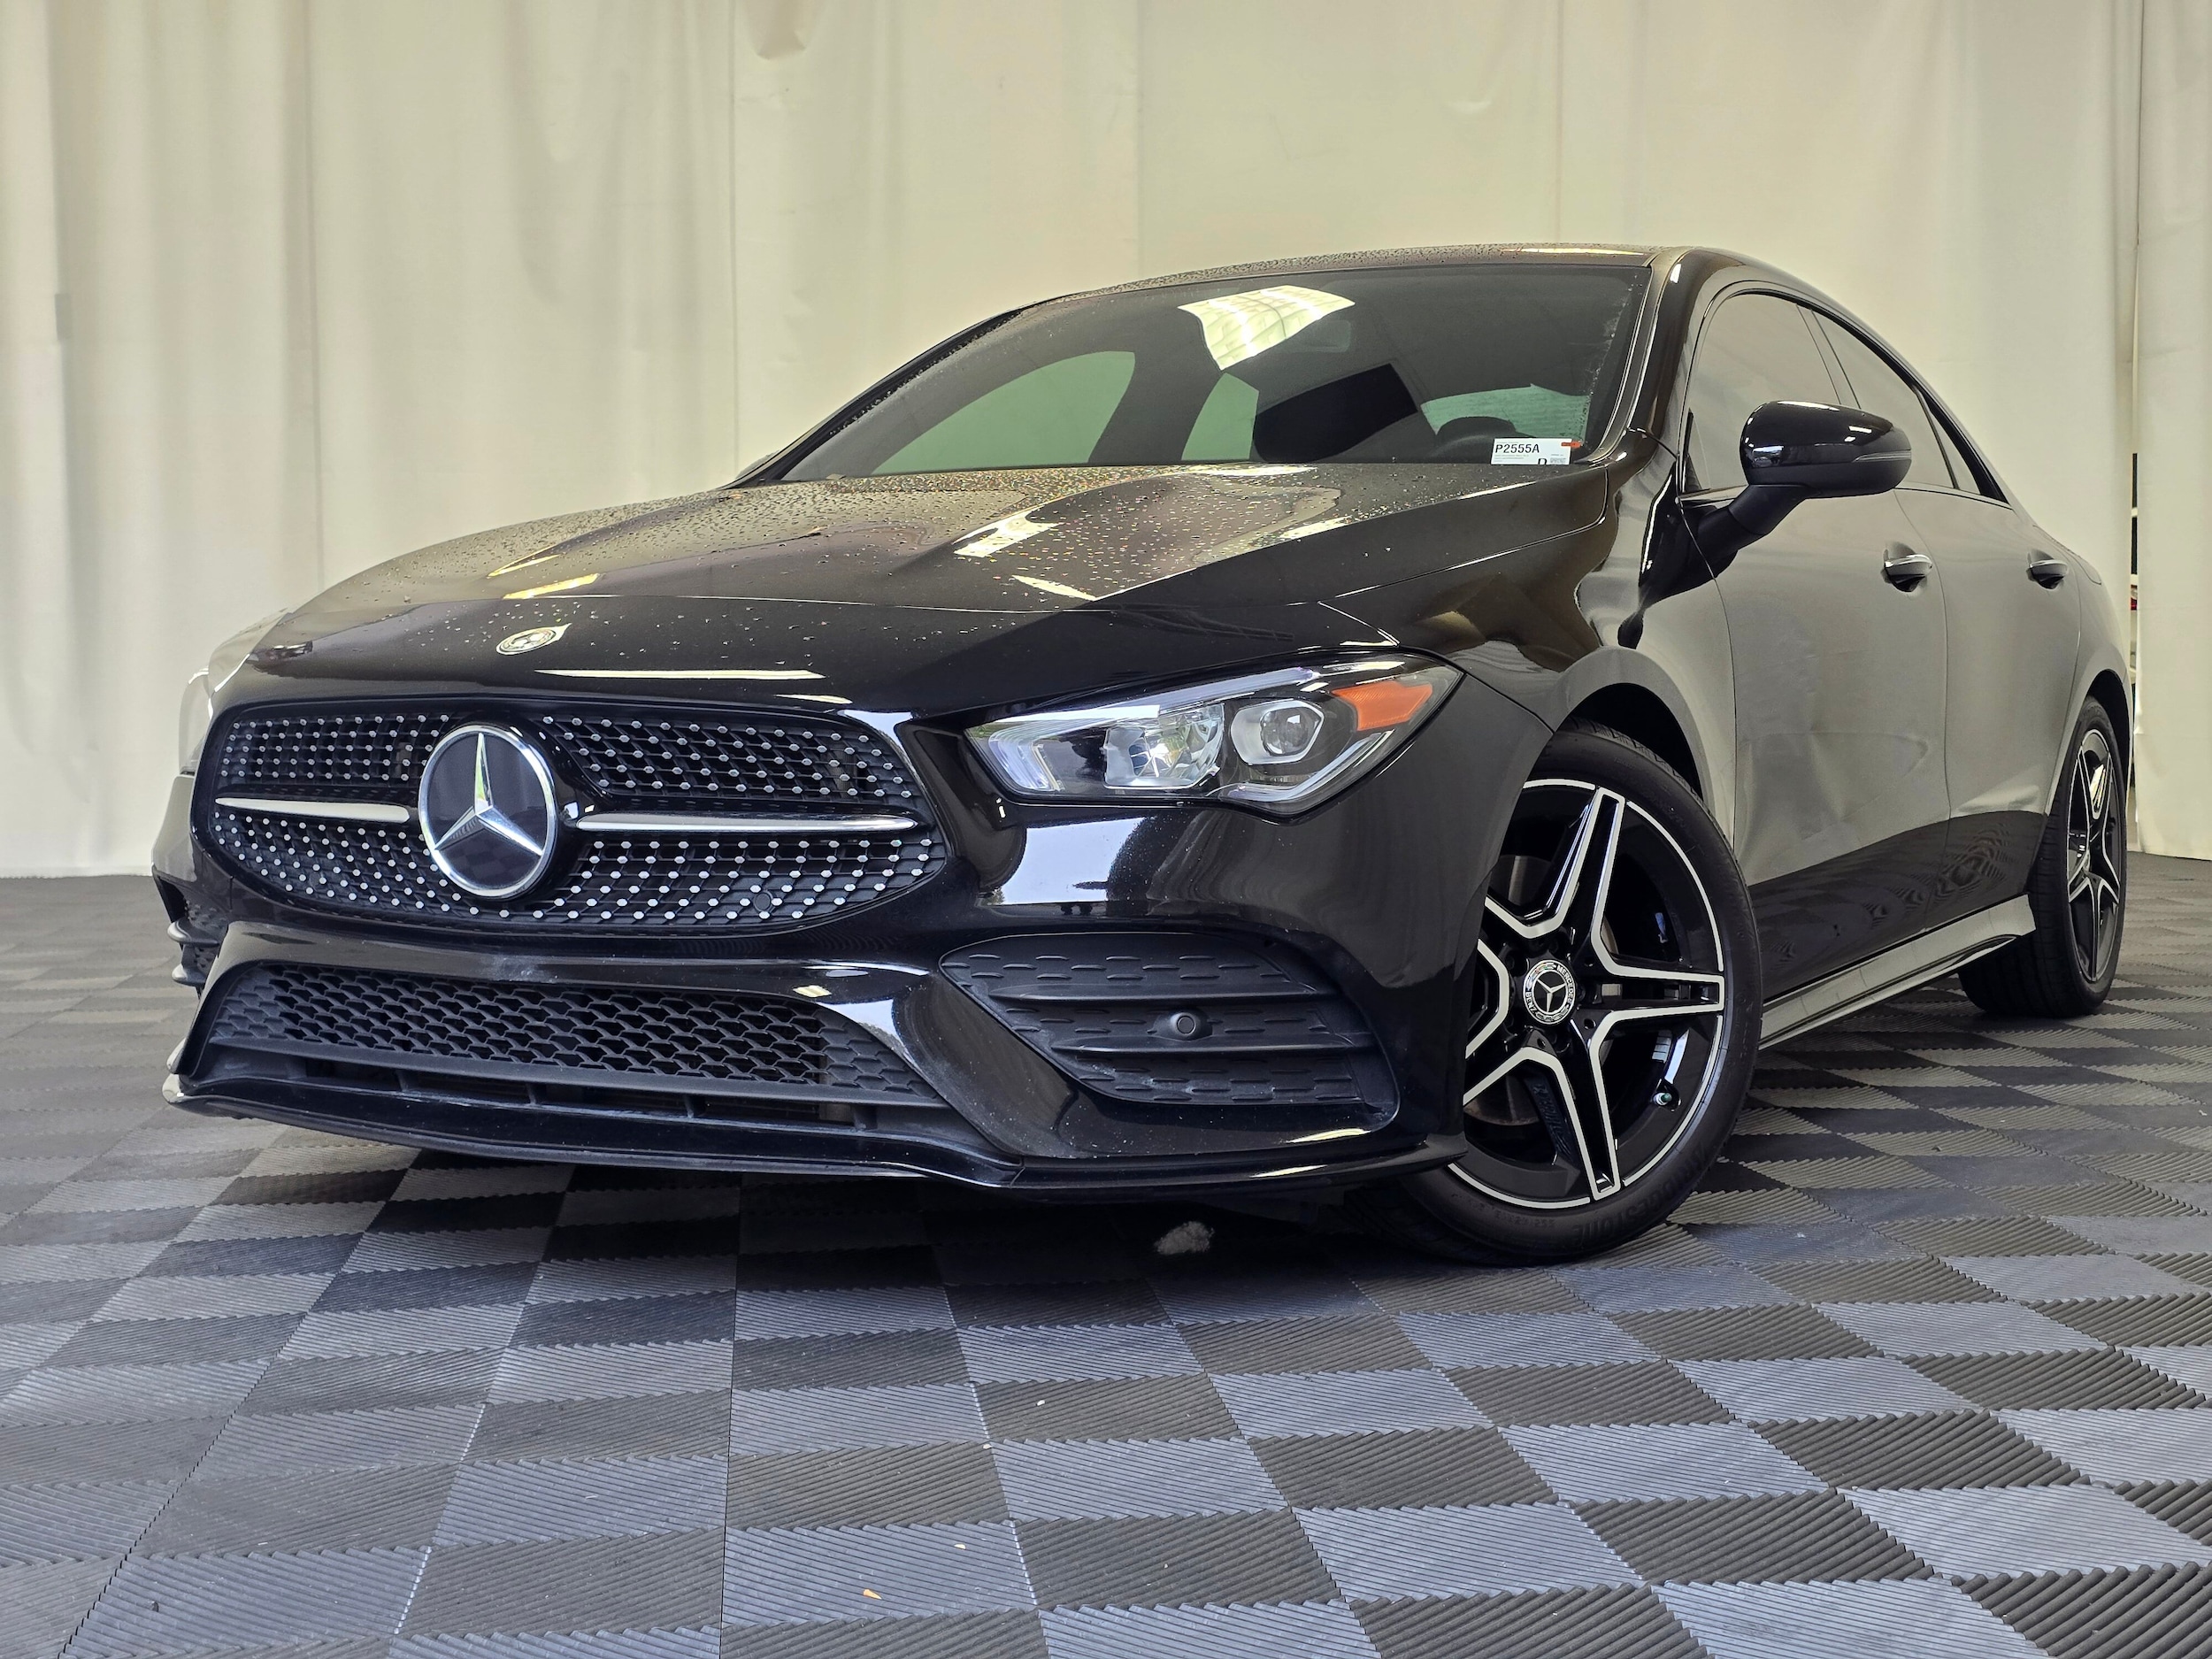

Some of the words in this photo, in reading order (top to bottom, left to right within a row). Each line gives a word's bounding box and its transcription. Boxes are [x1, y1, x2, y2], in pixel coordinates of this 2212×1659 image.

[1495, 443, 1540, 454] P2555A
[1556, 965, 1574, 1004] MERCEDES
[1525, 993, 1538, 1013] BENZ
